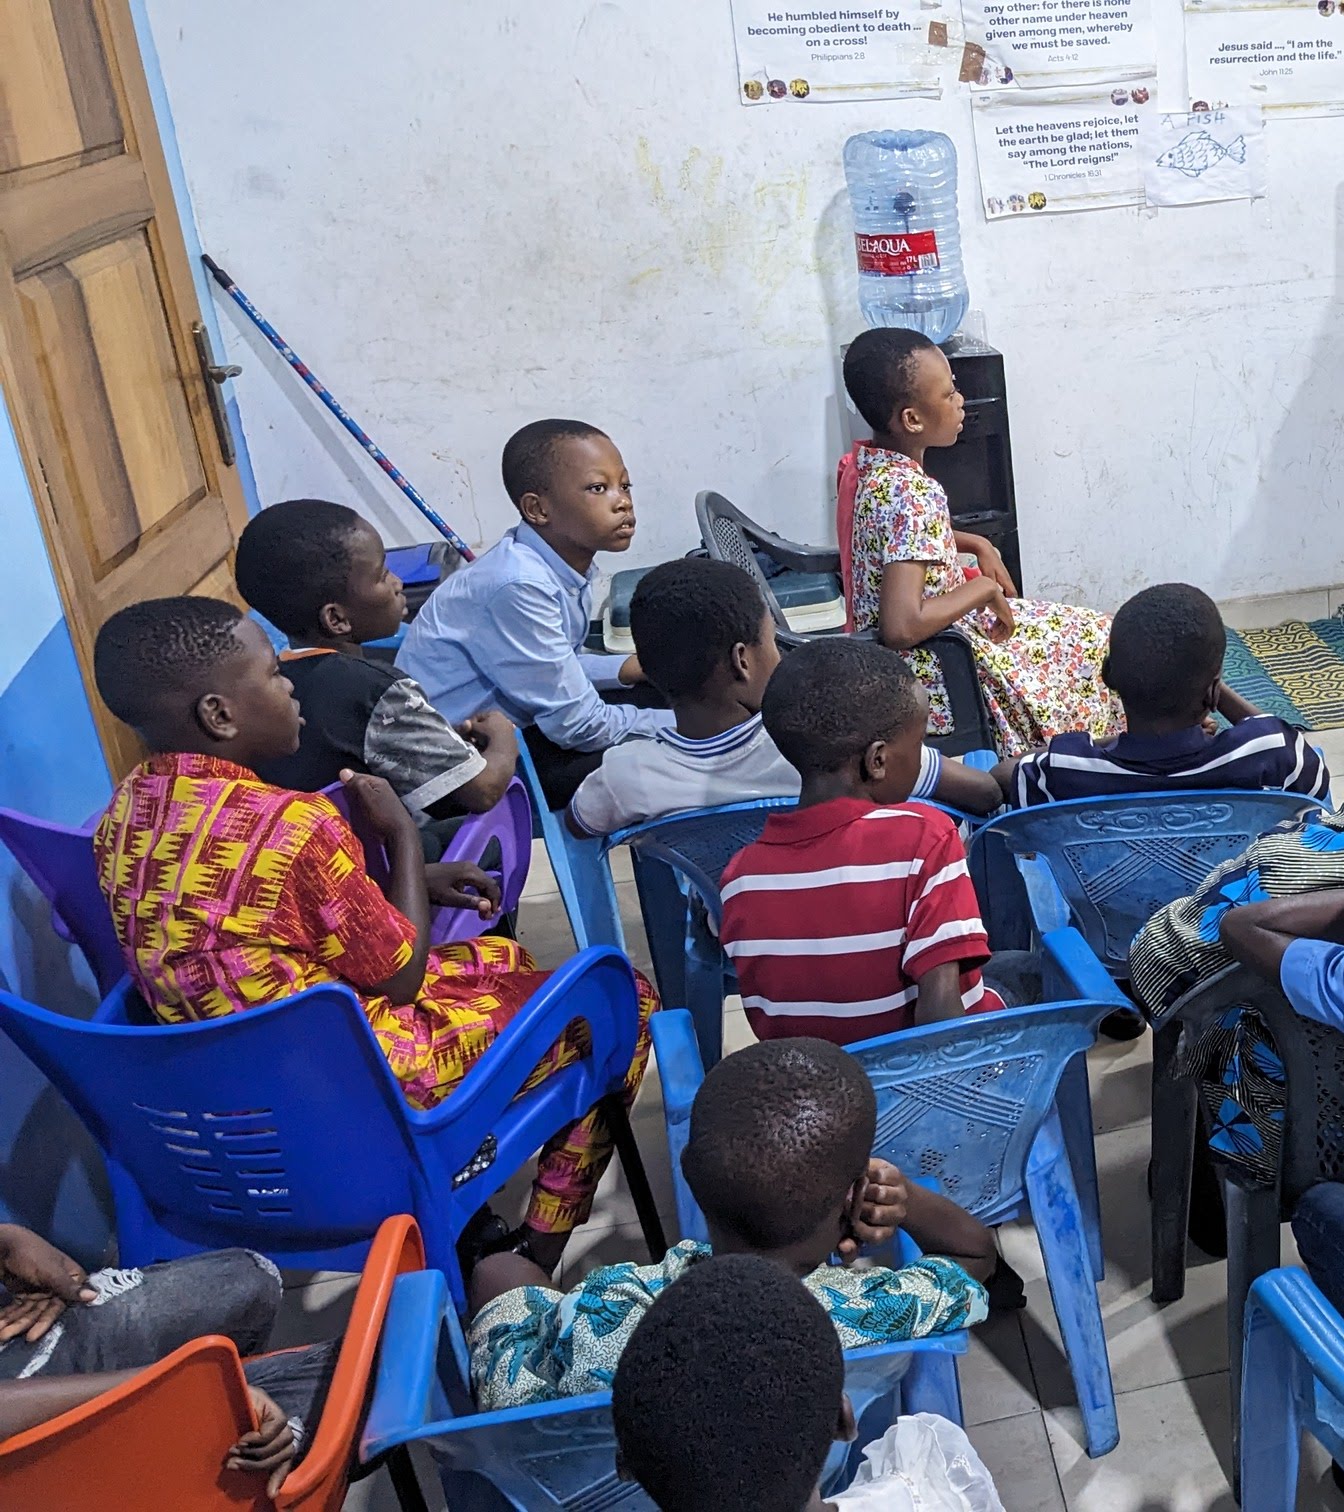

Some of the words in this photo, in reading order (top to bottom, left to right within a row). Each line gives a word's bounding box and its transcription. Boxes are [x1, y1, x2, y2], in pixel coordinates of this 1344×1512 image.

[984, 4, 1004, 14] any
[1007, 3, 1040, 12] other:
[1042, 1, 1058, 10] for
[1061, 0, 1090, 9] there
[768, 13, 783, 22] He
[786, 11, 837, 21] humbled
[840, 10, 883, 20] himself
[886, 10, 899, 20] by
[989, 16, 1020, 26] other
[1055, 13, 1086, 22] under
[1089, 11, 1128, 21] heaven
[748, 26, 806, 36] becoming
[808, 24, 860, 34] obedient
[863, 24, 876, 32] to
[878, 22, 911, 32] death
[986, 30, 1016, 40] given
[1019, 28, 1056, 38] among
[1059, 27, 1085, 36] men,
[1087, 22, 1133, 33] whereby
[806, 38, 820, 47] on
[823, 38, 830, 46] a
[832, 36, 867, 46] cross!
[1012, 42, 1028, 50] we
[1030, 40, 1058, 49] must
[1061, 38, 1074, 47] be
[1076, 36, 1110, 46] saved.
[1218, 42, 1248, 51] Jesus
[1250, 41, 1272, 50] said
[1316, 39, 1333, 48] the
[1209, 53, 1274, 64] resurrection
[1277, 53, 1296, 61] and
[1299, 52, 1316, 60] the
[996, 125, 1013, 135] Let
[1016, 123, 1034, 133] the
[1036, 120, 1081, 132] heavens
[1083, 116, 1123, 128] rejoice,
[1124, 114, 1139, 123] let
[1161, 114, 1175, 129] A
[1186, 112, 1226, 126] FISH
[999, 138, 1016, 147] the
[1019, 135, 1049, 145] earth
[1051, 133, 1064, 142] be
[1066, 132, 1093, 143] glad;
[1095, 130, 1109, 138] let
[1111, 127, 1139, 137] them
[1008, 150, 1027, 160] say
[1029, 147, 1066, 157] among
[1069, 144, 1087, 153] the
[1089, 140, 1132, 151] nations,
[1050, 157, 1076, 166] Lord
[1048, 172, 1086, 181] Chronicles
